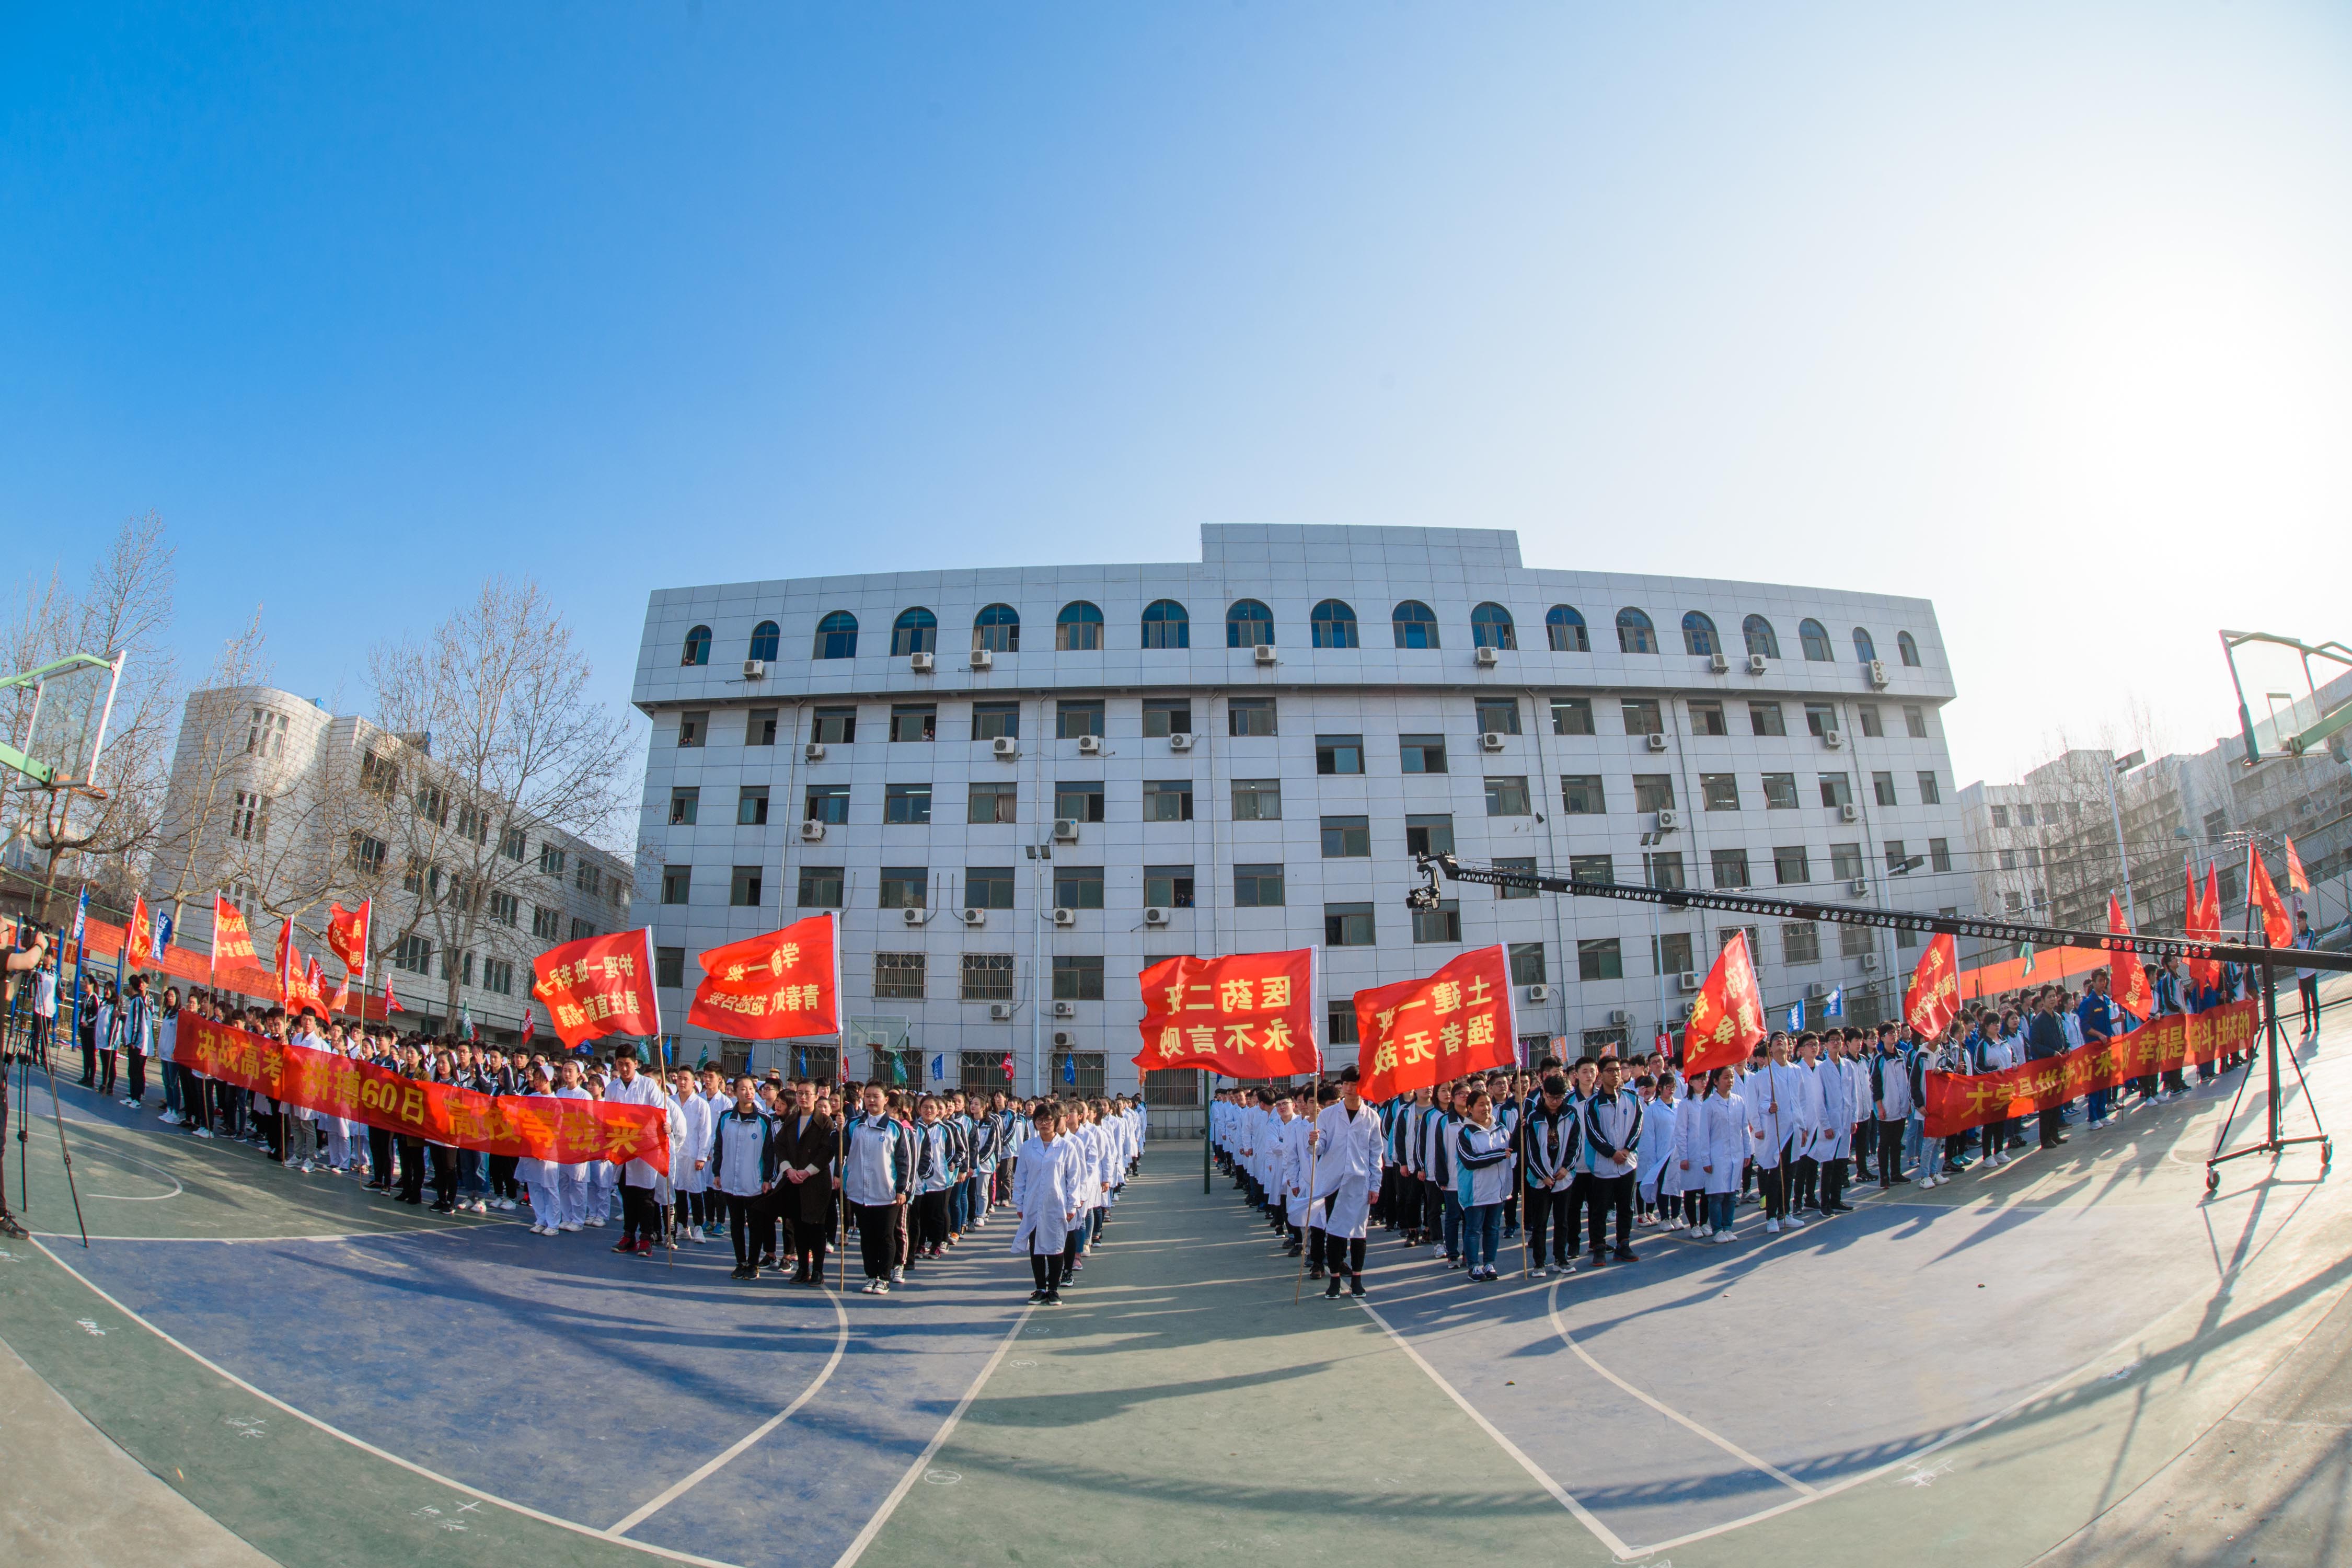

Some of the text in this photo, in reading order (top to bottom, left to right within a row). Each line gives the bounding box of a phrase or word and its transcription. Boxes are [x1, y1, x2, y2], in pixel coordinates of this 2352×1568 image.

[196, 1029, 643, 1154] 决战高考 拼搏60日 高校等我来
